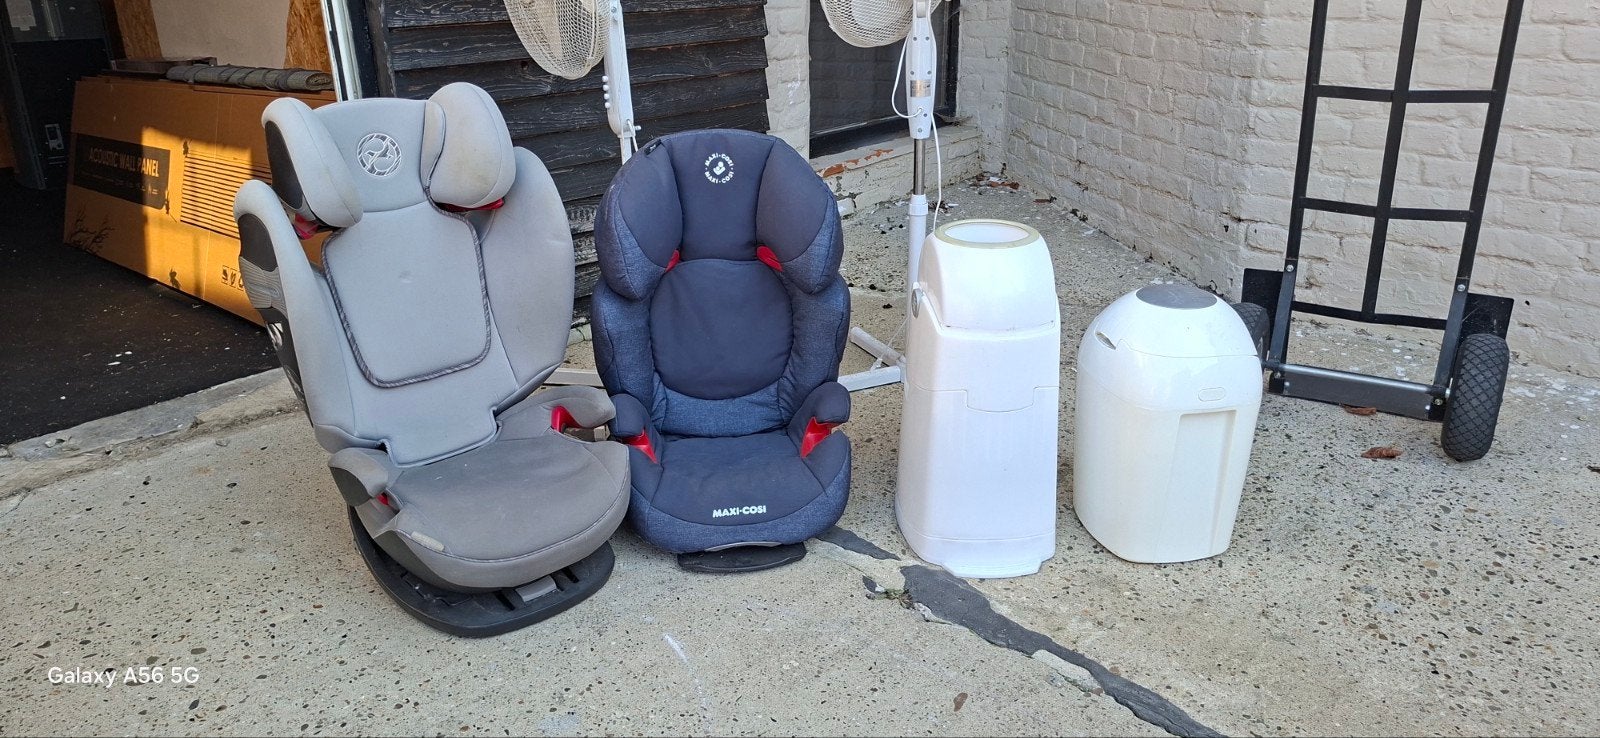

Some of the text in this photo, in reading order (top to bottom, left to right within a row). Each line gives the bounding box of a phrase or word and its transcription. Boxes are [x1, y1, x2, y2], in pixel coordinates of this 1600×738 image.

[119, 152, 136, 172] WALL
[137, 156, 160, 178] PANEL
[712, 505, 767, 518] MAXI-COSI
